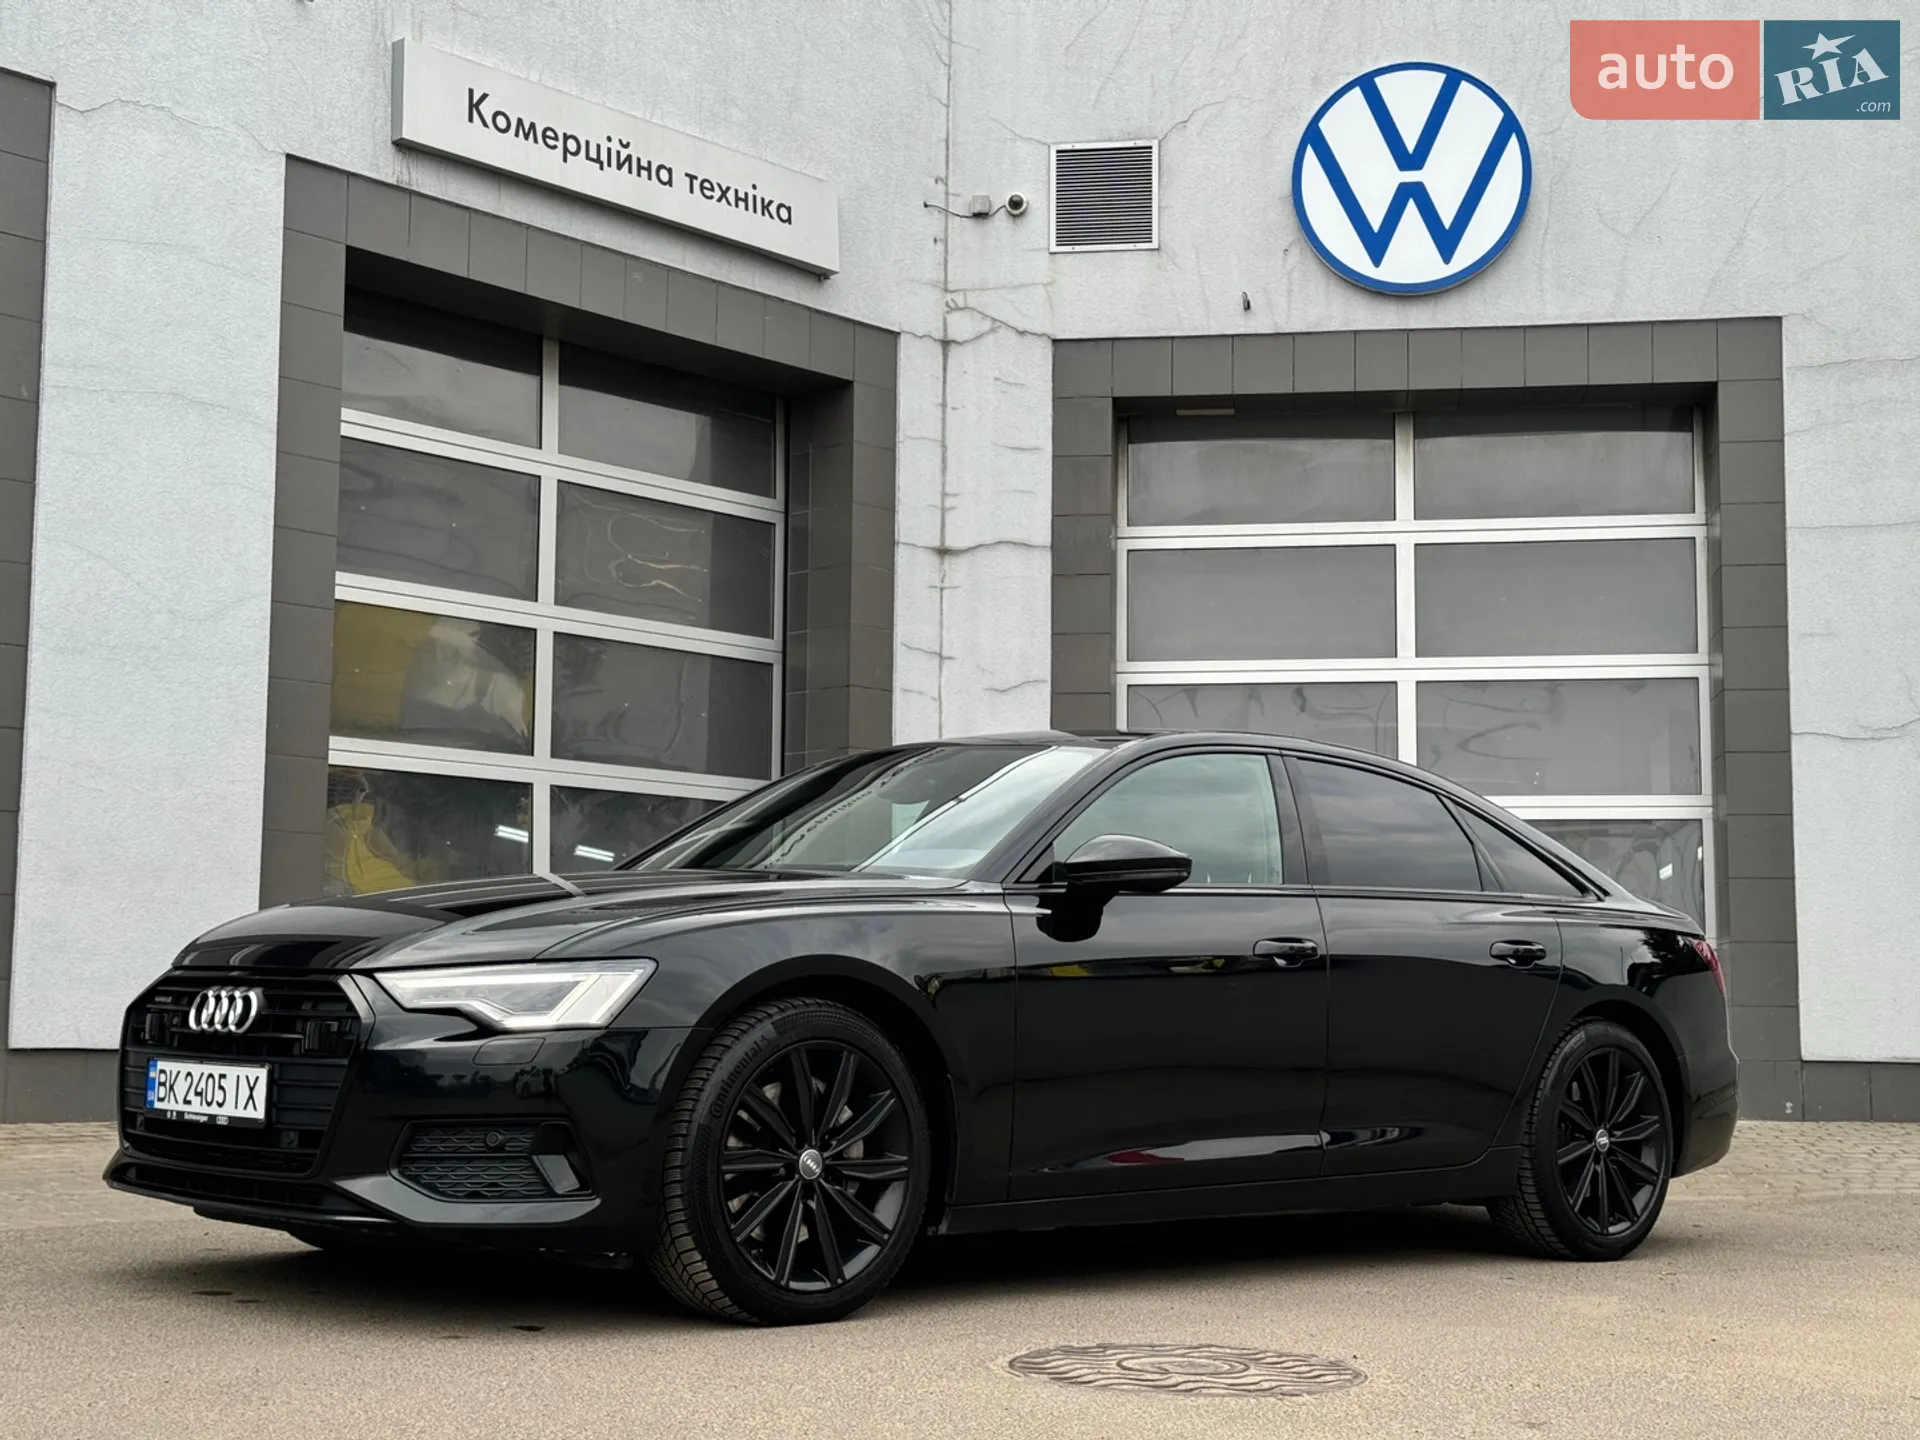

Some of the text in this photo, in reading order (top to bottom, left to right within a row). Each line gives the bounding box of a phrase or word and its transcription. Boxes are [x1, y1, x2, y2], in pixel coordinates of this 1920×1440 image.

[467, 87, 793, 225] Комерційна техніка
[1300, 66, 1524, 272] VW
[157, 1068, 260, 1112] BK 2405 IX
